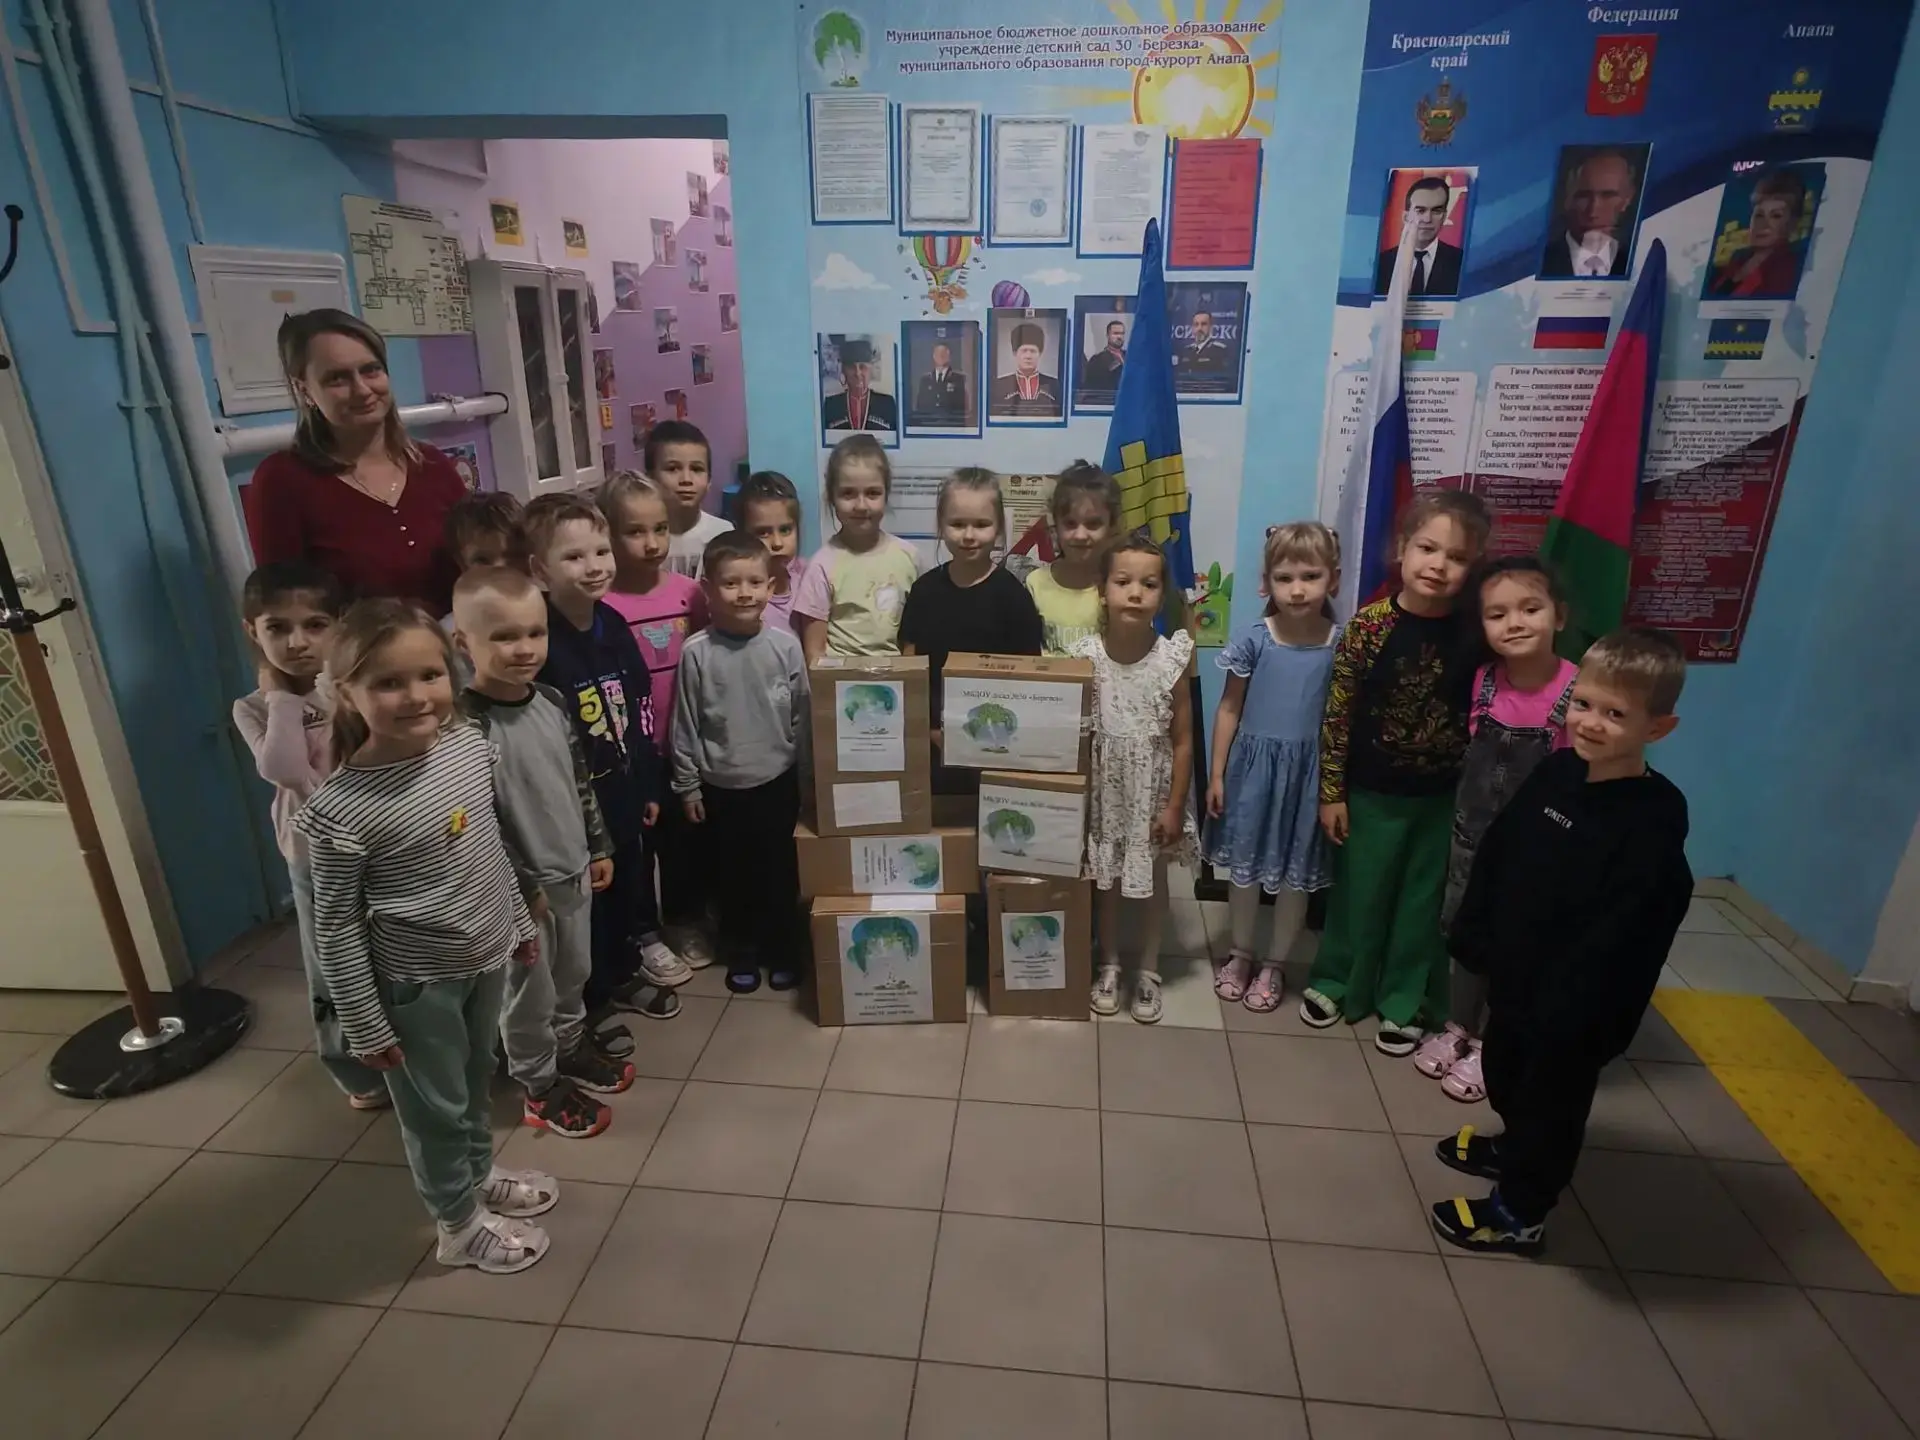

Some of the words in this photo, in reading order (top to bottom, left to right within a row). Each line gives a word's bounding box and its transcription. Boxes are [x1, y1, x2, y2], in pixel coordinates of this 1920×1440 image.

[1587, 6, 1680, 26] Федерация
[886, 28, 993, 44] Муниципальное
[996, 26, 1077, 40] бюджетное
[1081, 24, 1169, 38] дошкольное
[1173, 21, 1266, 36] образование
[1391, 29, 1511, 53] Краснодарский
[1783, 24, 1836, 39] Анапа
[938, 44, 1021, 59] учреждение
[1025, 40, 1081, 56] детский
[1087, 42, 1110, 54] сад
[1115, 40, 1132, 52] 30
[899, 60, 1011, 75] муниципального
[1015, 56, 1104, 73] образования
[1109, 55, 1201, 71] город-курорт
[1207, 53, 1250, 66] Анапа
[1430, 51, 1469, 71] край
